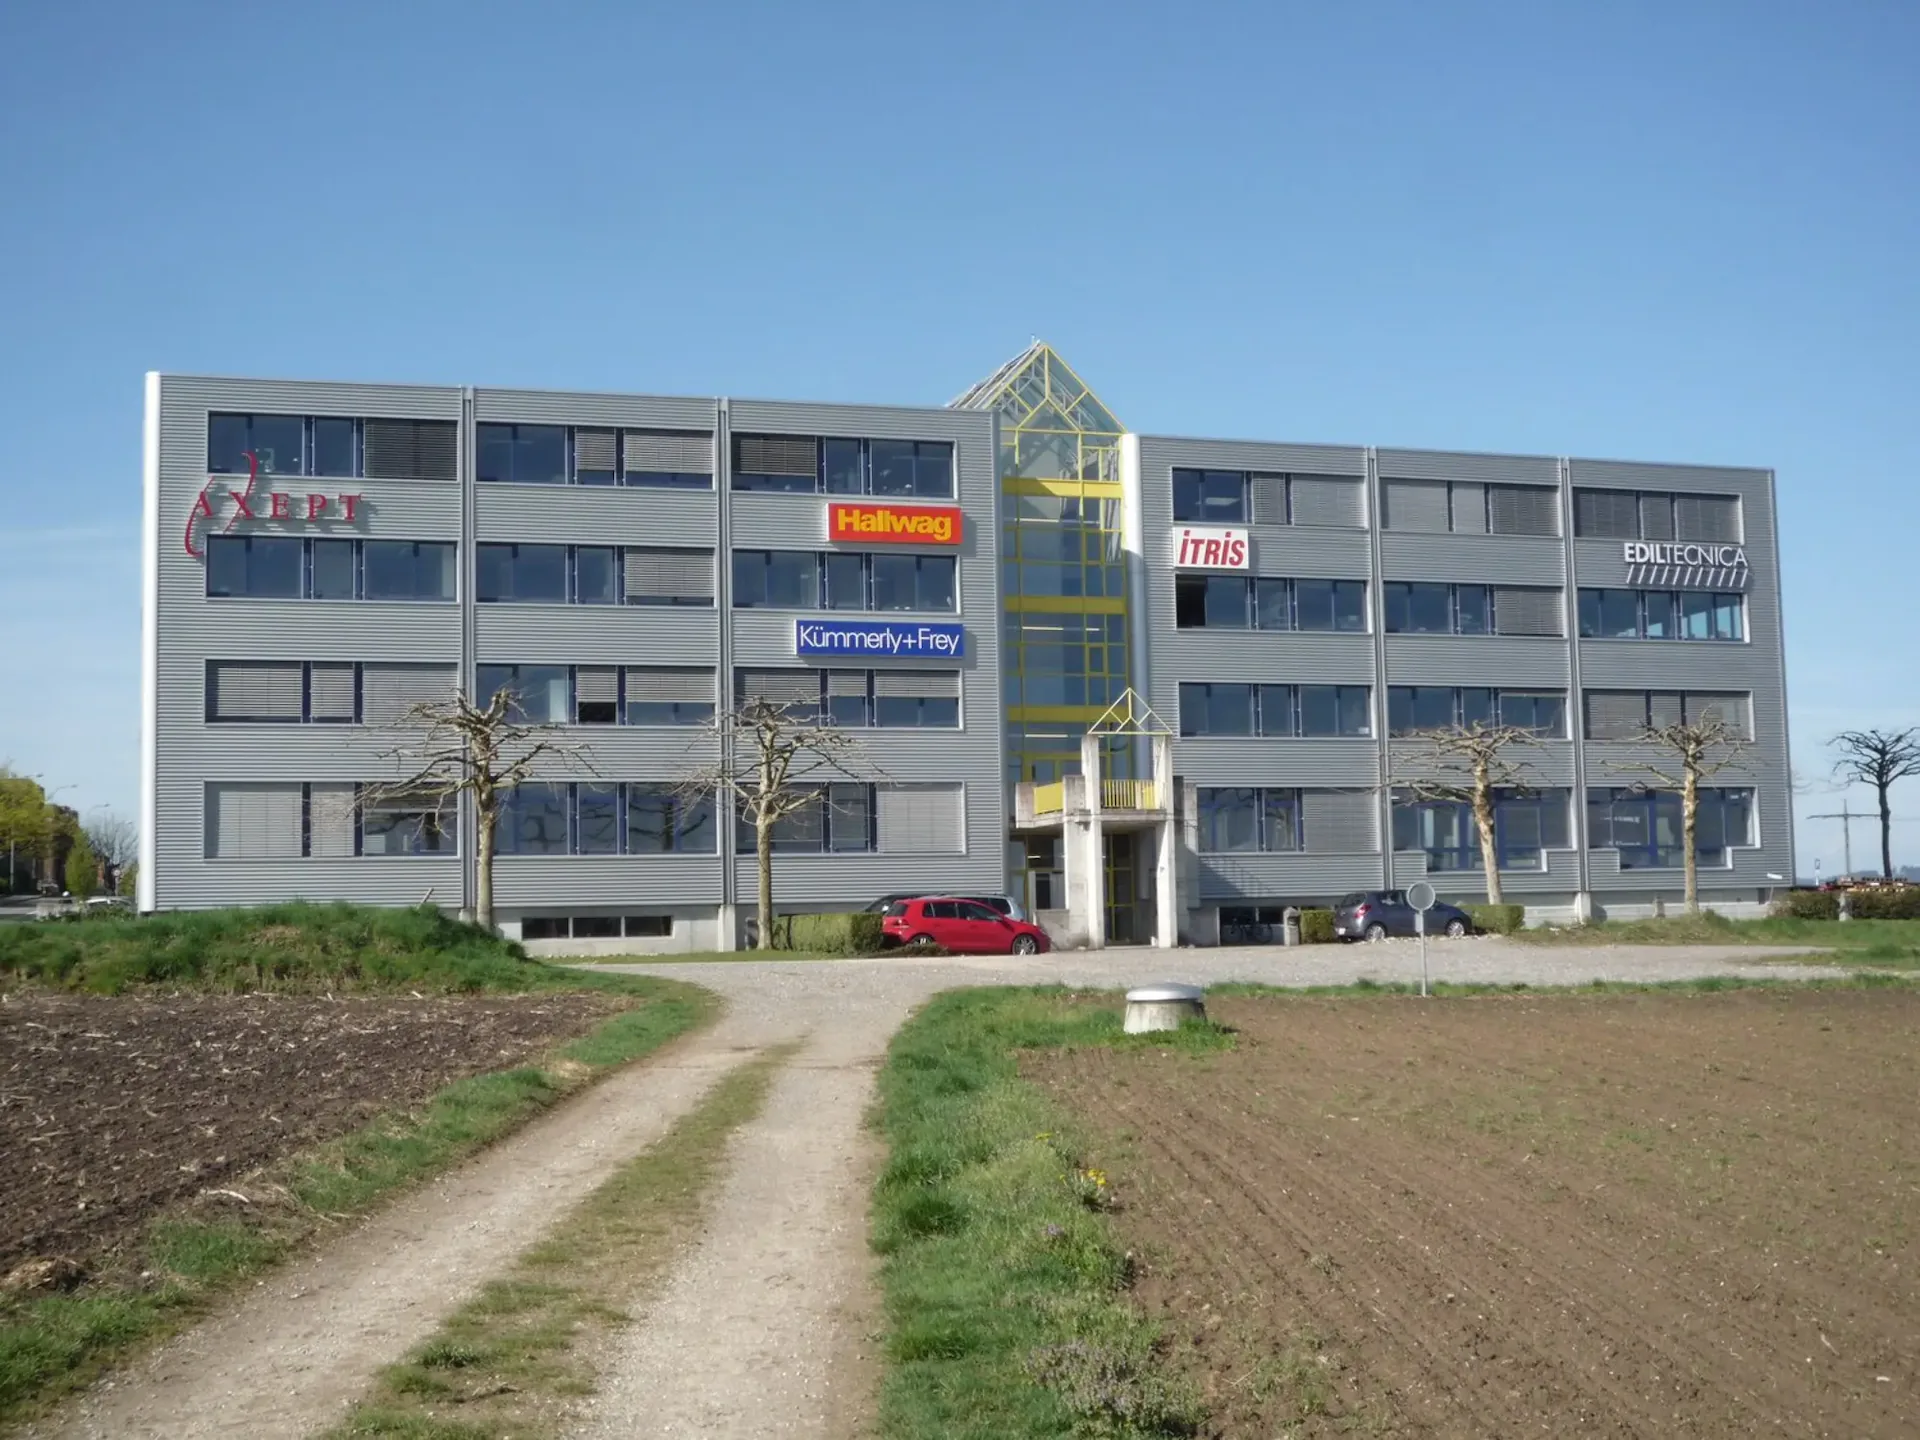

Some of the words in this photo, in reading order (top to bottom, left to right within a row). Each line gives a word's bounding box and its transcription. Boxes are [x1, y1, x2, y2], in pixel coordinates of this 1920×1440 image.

[185, 451, 362, 557] AXEPT
[837, 509, 953, 541] Hallwag
[1624, 543, 1748, 567] EDILTECNICA
[800, 625, 960, 655] Kümmerly+Frey
